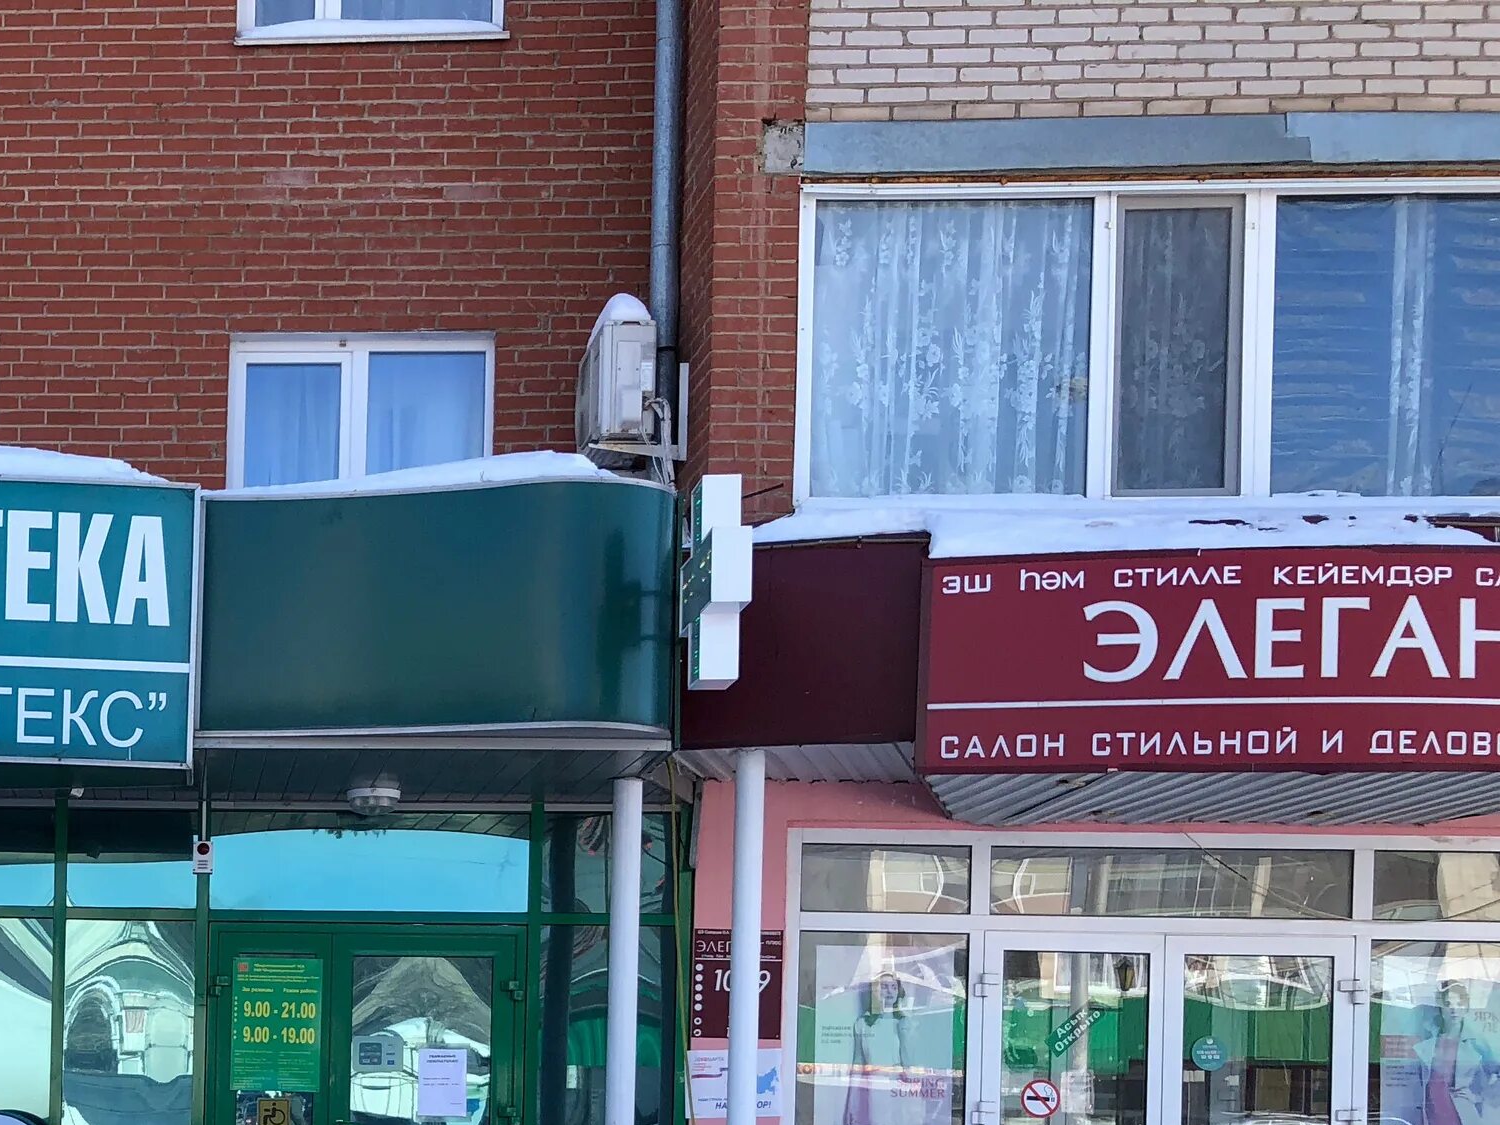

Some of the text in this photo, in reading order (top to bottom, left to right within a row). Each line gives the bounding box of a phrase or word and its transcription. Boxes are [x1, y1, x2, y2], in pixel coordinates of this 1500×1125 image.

[1113, 565, 1242, 587] СТИЛЛЕ
[940, 727, 1500, 759] САЛОН СТИЛЬНОЙ И ДЕЛОВ
[696, 940, 732, 953] ЭЛЕГ
[243, 1001, 270, 1017] 9.00
[281, 1002, 316, 1018] 21.00
[243, 1026, 270, 1043] 9.00
[281, 1027, 316, 1044] 19.00
[1054, 1010, 1101, 1052] Открыто
[890, 1088, 945, 1098] SUMMER
